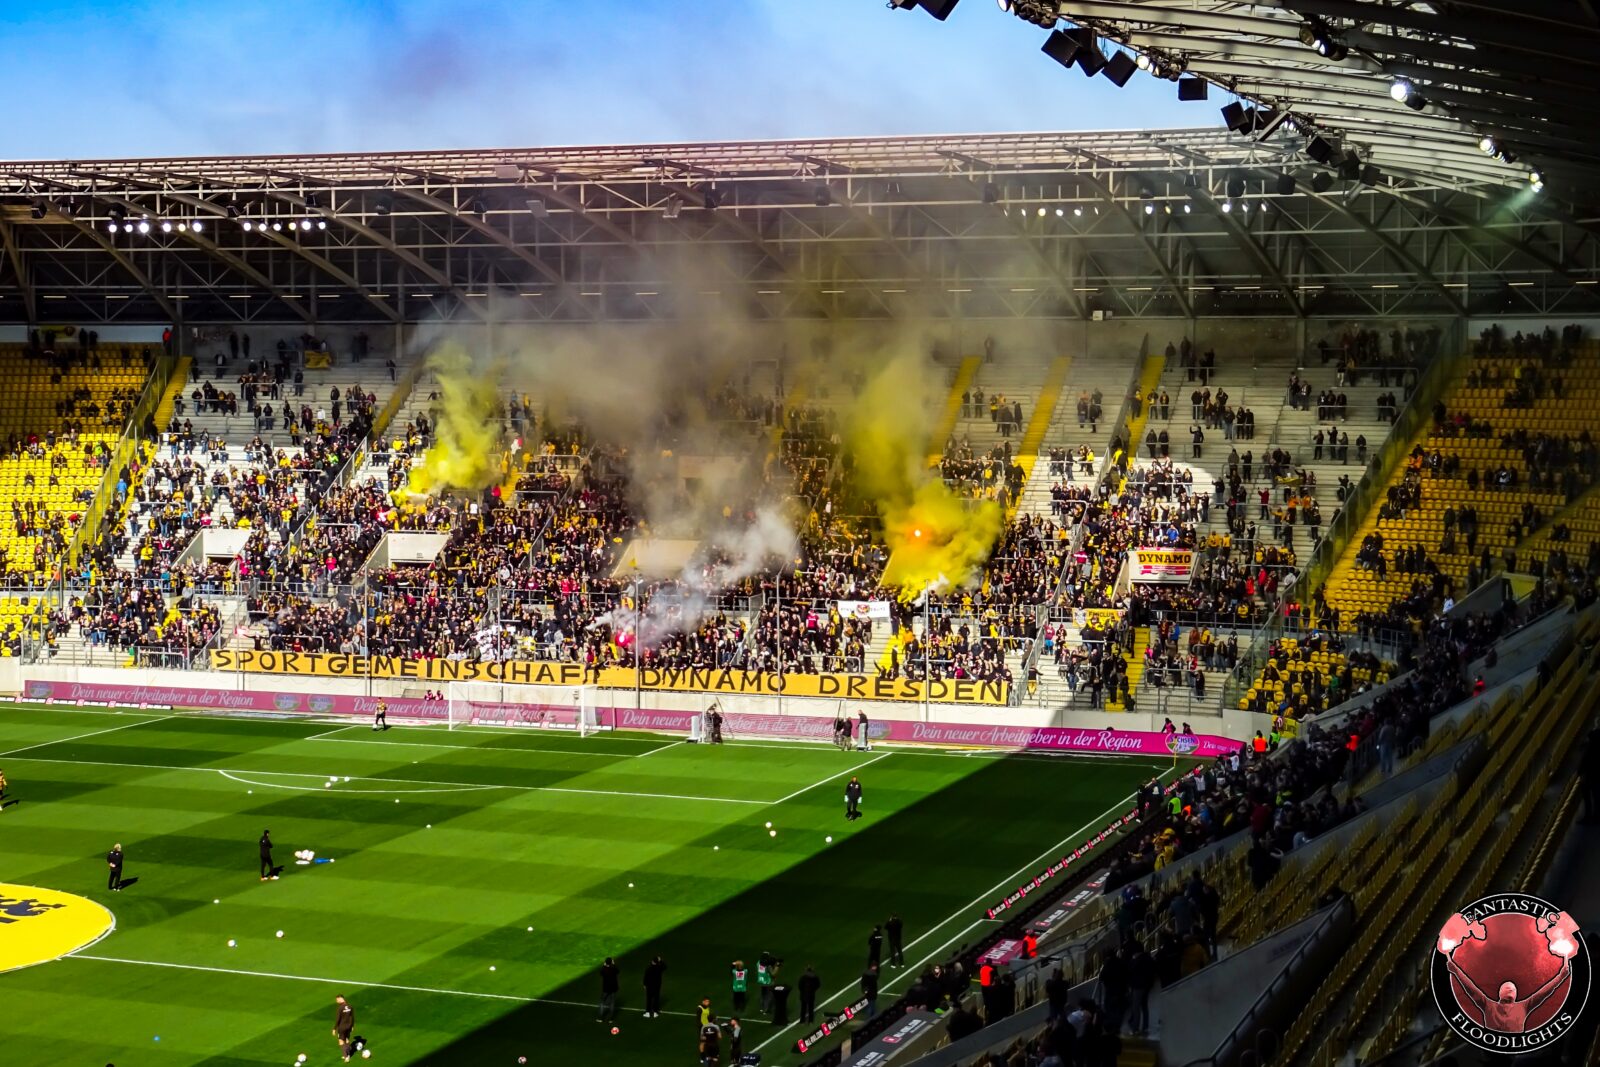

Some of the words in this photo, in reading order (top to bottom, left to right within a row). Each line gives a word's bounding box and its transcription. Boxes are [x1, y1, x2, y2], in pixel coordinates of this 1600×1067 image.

[1138, 553, 1191, 564] DYNAMO
[641, 667, 786, 692] DYNAMO
[819, 675, 1001, 701] DRESDEN
[71, 684, 95, 698] Dein
[97, 688, 125, 700] neuer
[125, 686, 186, 705] Arbeitgeber
[187, 692, 198, 703] in
[200, 690, 216, 703] der
[218, 691, 254, 706] Region
[622, 709, 649, 725] Dein
[652, 716, 685, 727] neuer
[912, 723, 942, 739] Dein
[944, 729, 980, 741] neuer
[980, 727, 1057, 747] Arbeitgeber
[1059, 731, 1071, 744] in
[1074, 730, 1096, 746] der
[1098, 731, 1142, 750] Region
[1169, 736, 1195, 744] SCHSEN
